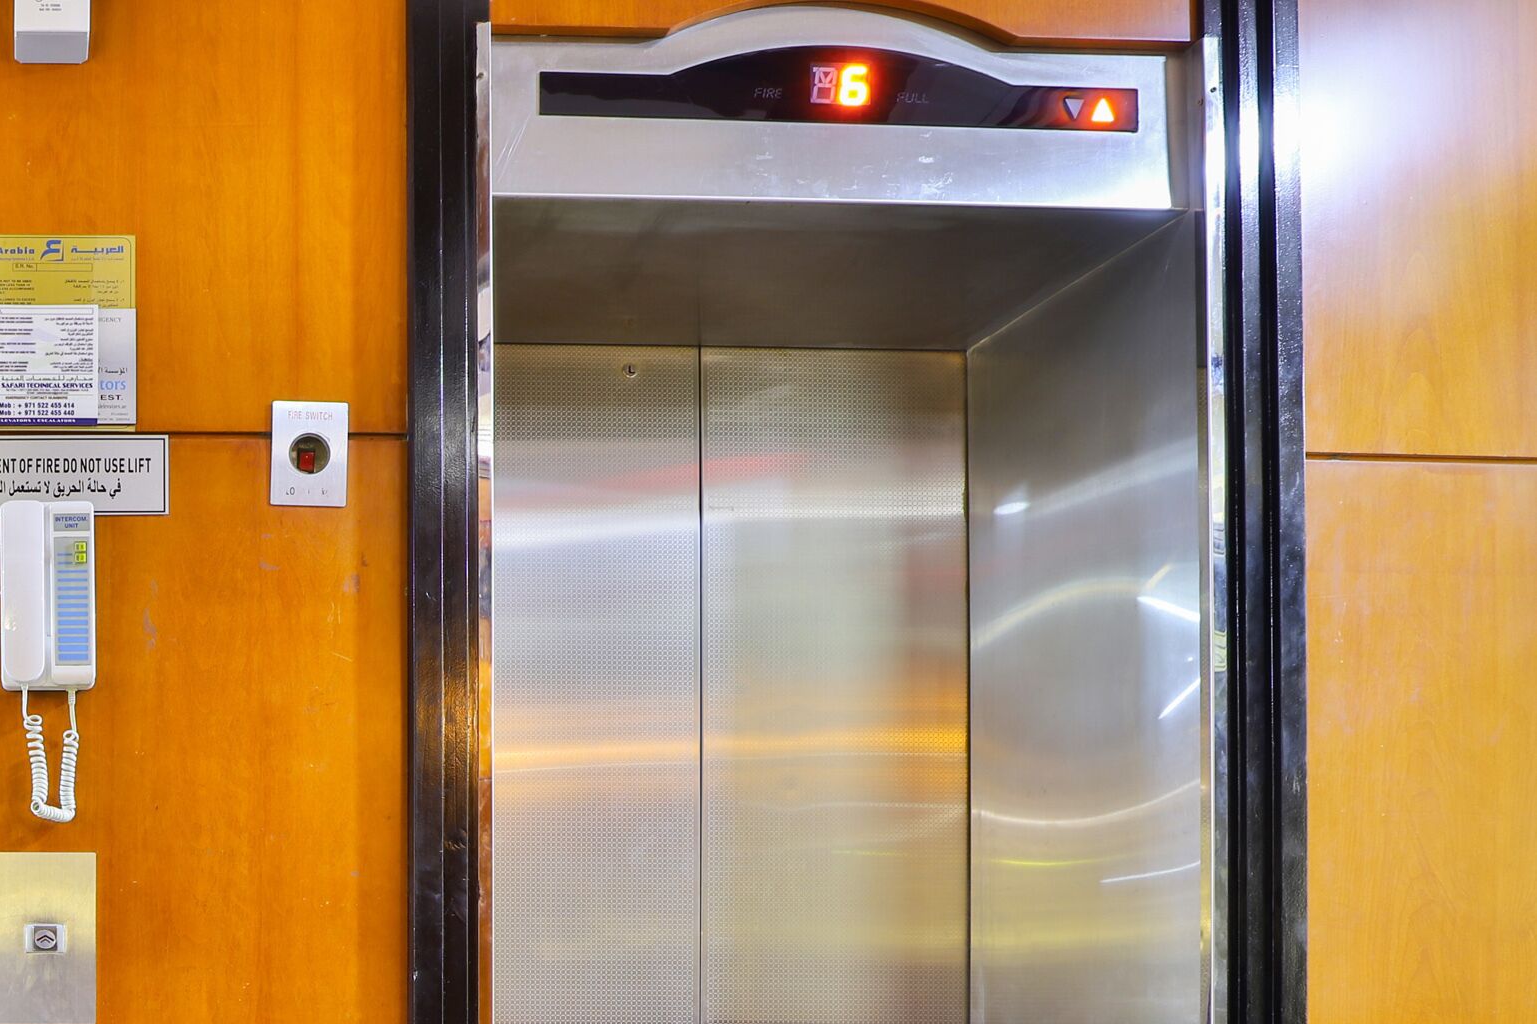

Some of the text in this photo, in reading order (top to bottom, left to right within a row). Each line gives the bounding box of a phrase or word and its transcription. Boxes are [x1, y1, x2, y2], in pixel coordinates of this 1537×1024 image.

[839, 64, 869, 106] 6
[753, 88, 783, 98] FIRE
[896, 92, 929, 104] FULL
[71, 246, 124, 254] العربية
[288, 410, 333, 420] FIRE SWITCH
[19, 458, 33, 473] OF
[36, 458, 60, 473] FIRE
[63, 458, 77, 473] DO
[80, 458, 101, 473] NOT
[104, 458, 125, 473] USE
[128, 458, 151, 473] LIFT
[9, 480, 41, 496] تستعمل
[44, 481, 50, 494] لا
[53, 480, 84, 498] الحريق
[87, 478, 106, 492] حالة
[109, 478, 121, 499] في
